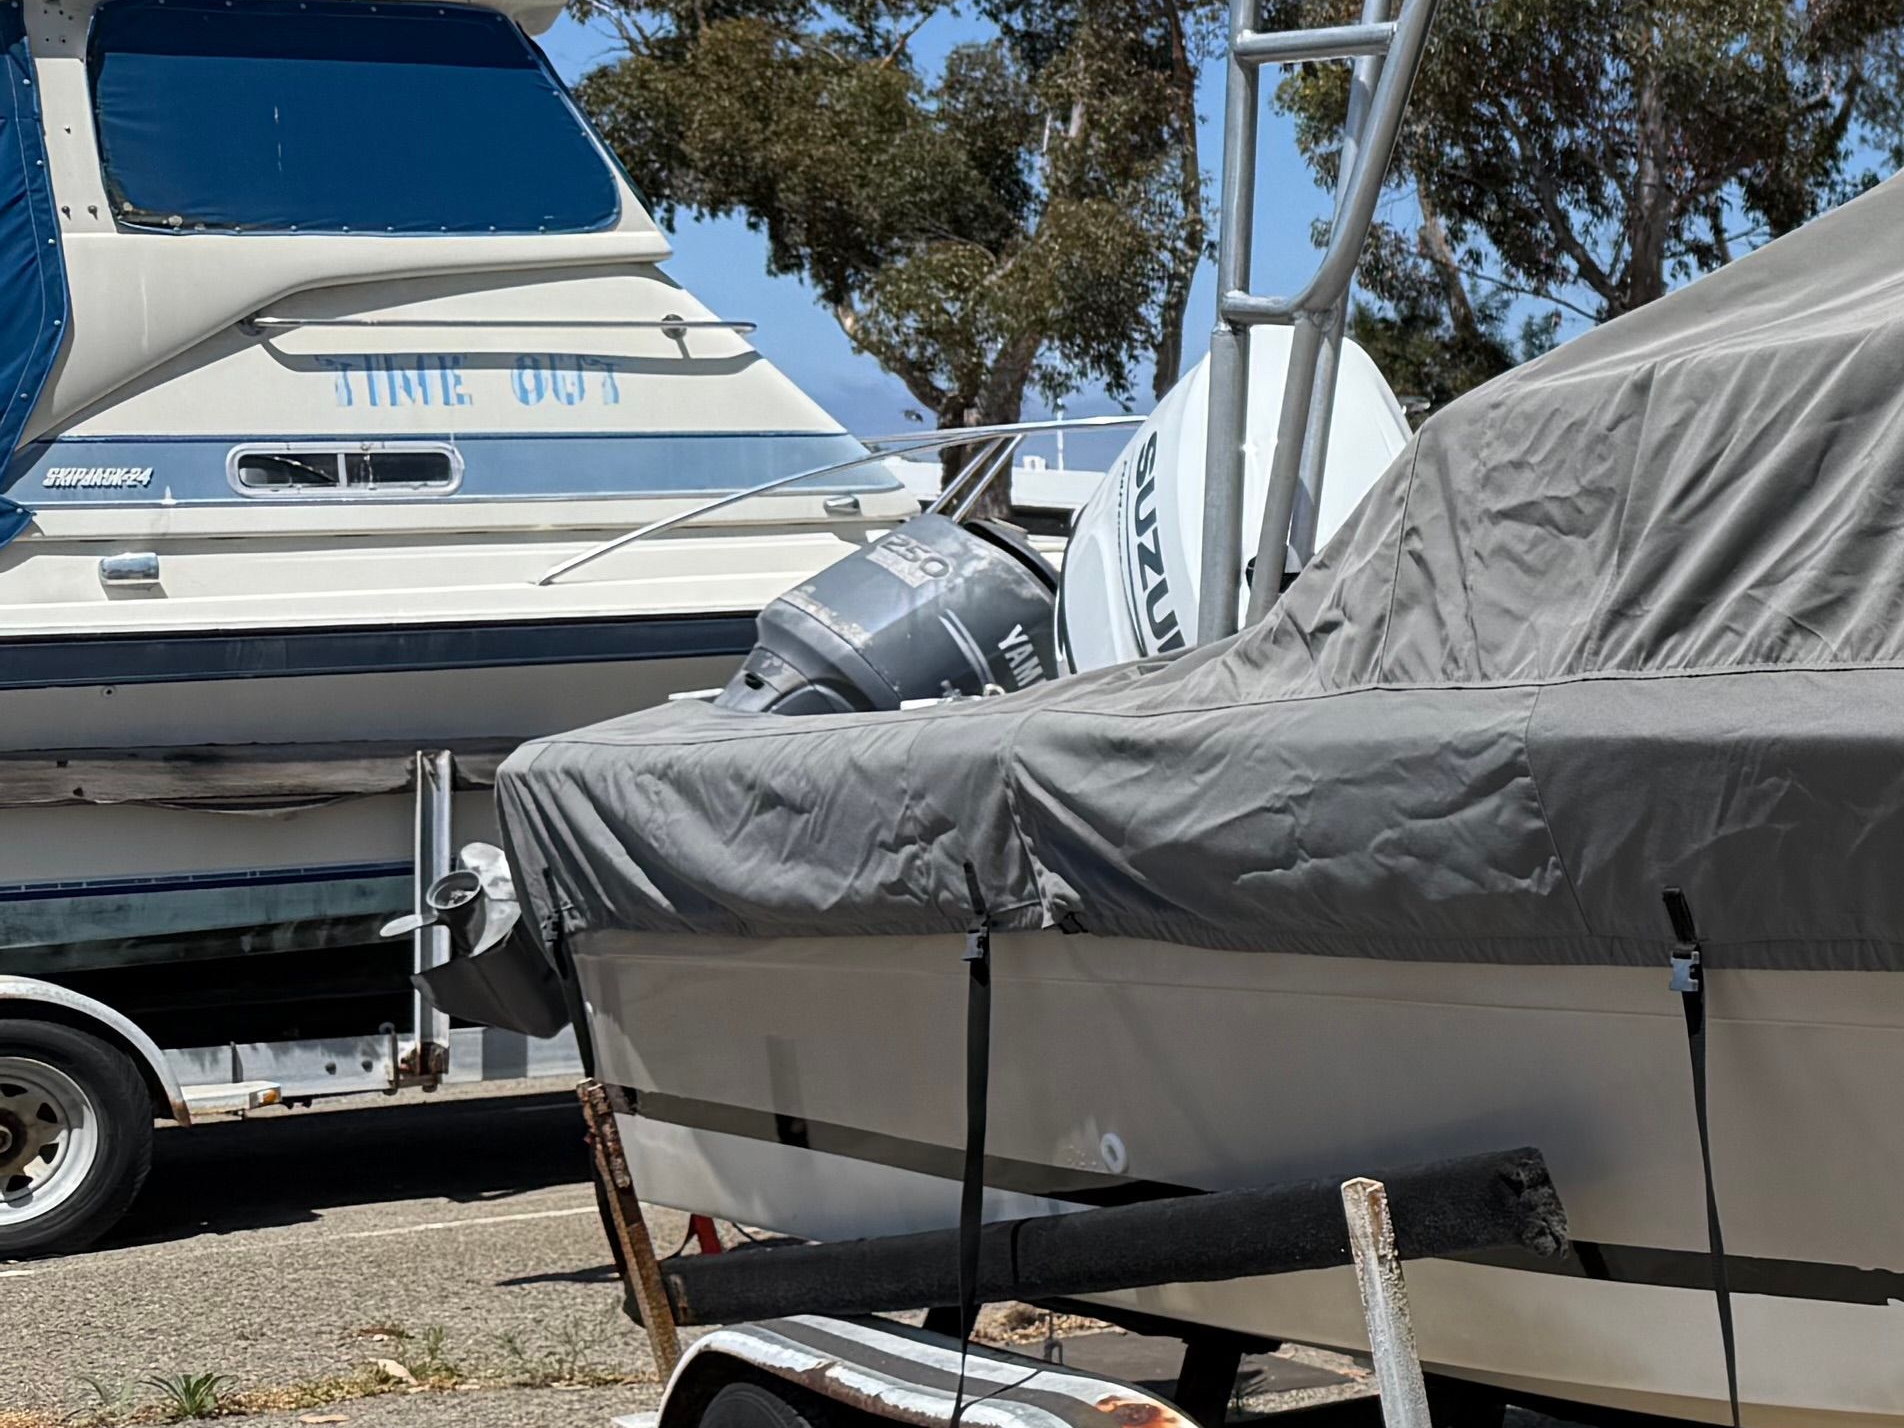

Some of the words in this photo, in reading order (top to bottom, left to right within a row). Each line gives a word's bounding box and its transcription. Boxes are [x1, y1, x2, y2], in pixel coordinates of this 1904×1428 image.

[315, 354, 473, 407] TIME
[510, 354, 621, 406] OUT
[881, 532, 951, 579] 250
[997, 624, 1047, 688] YAM
